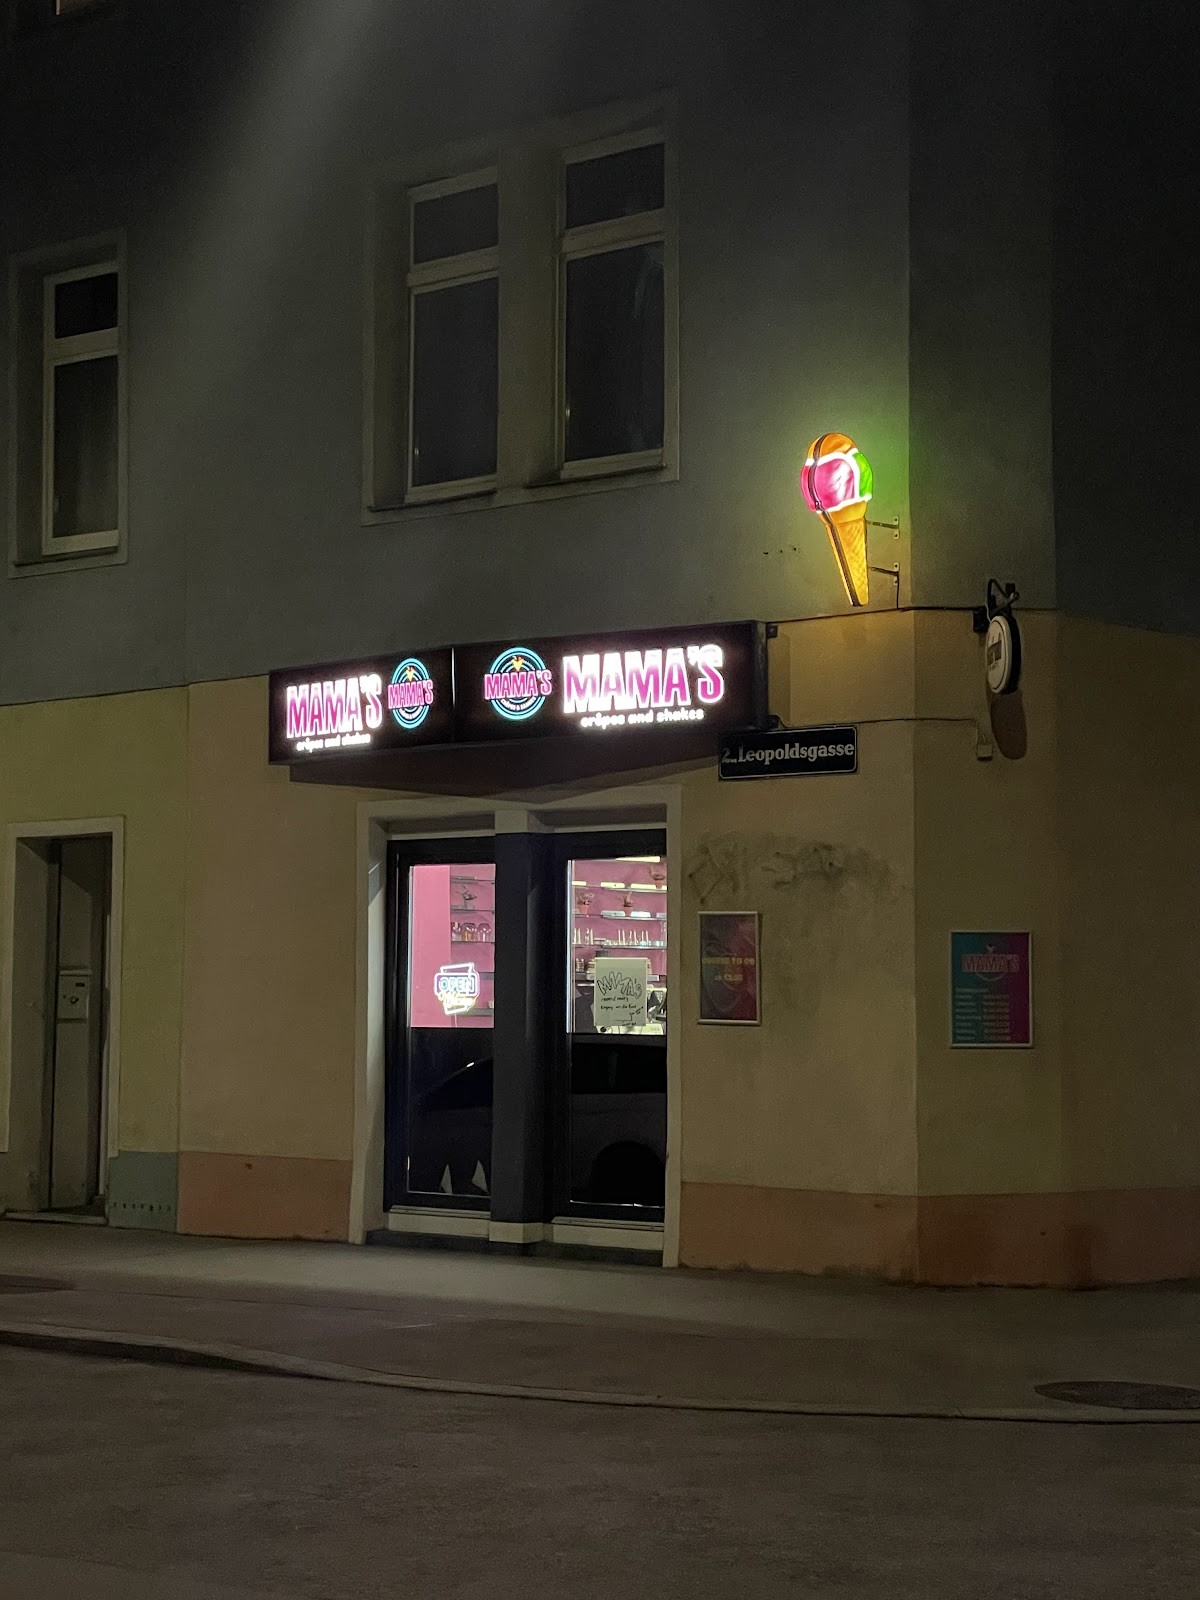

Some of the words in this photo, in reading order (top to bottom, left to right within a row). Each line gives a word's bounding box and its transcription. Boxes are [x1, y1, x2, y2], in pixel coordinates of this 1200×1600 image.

[484, 669, 552, 700] MAMA'S
[562, 643, 724, 714] MAMA'S
[286, 673, 383, 739] MAMA'S
[387, 679, 433, 709] MAMA'S
[628, 709, 653, 724] and
[657, 707, 705, 722] shakes
[738, 742, 855, 765] Leopoldsgasse
[962, 953, 1019, 972] MAMA'S
[439, 976, 475, 993] OPEN
